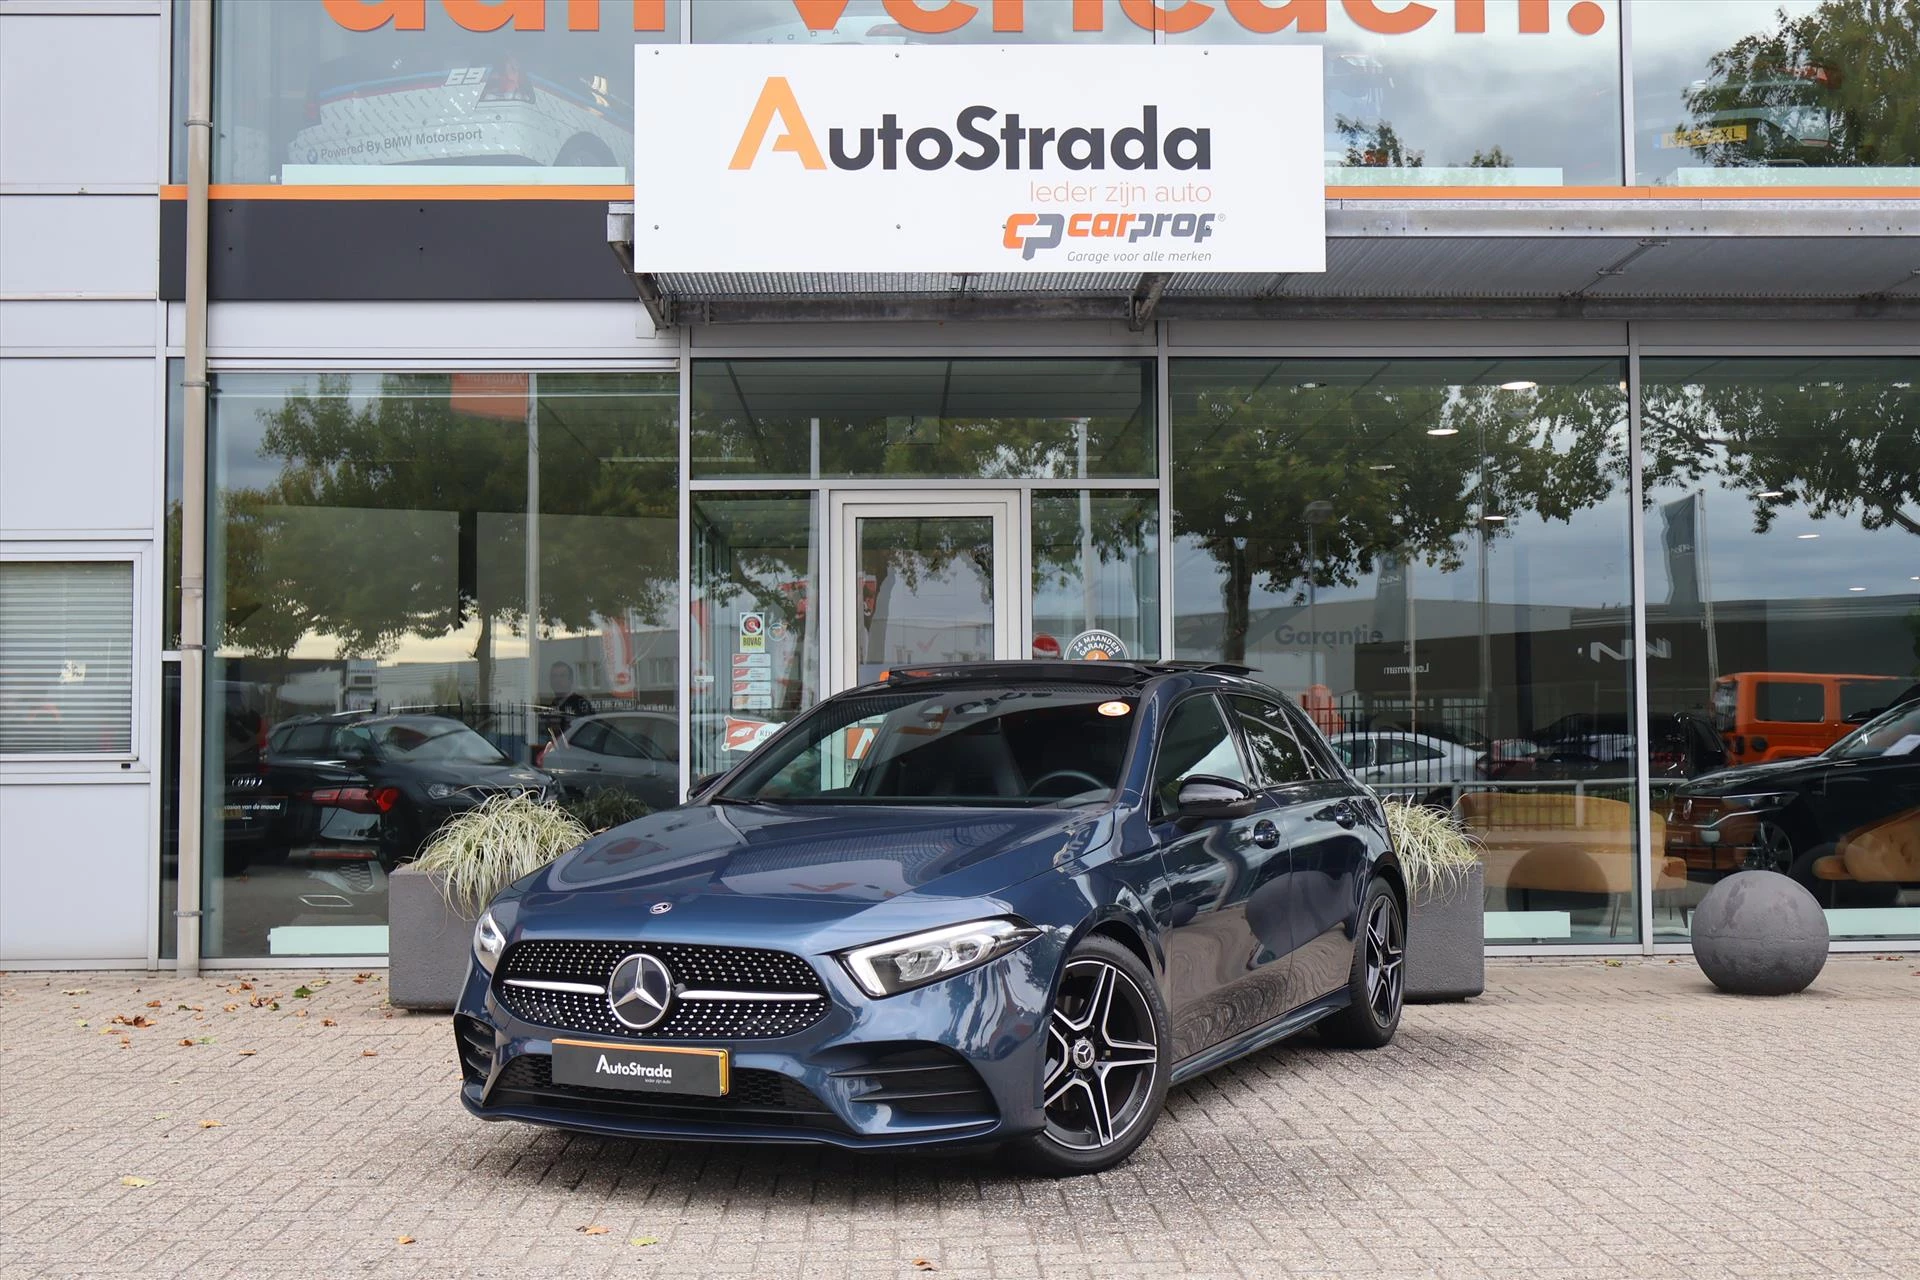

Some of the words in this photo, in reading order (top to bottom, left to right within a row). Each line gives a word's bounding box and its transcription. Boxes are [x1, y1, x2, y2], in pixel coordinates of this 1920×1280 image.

[445, 67, 486, 86] 69
[728, 77, 1211, 171] AutoStrada
[321, 142, 364, 160] Powered
[366, 141, 380, 153] By
[384, 135, 412, 149] BMW
[416, 129, 483, 146] Motorsport
[1030, 181, 1097, 203] Ieder
[1105, 181, 1146, 208] zijn
[1155, 182, 1212, 203] auto
[1067, 213, 1216, 243] carprof
[1067, 251, 1109, 264] Garage
[1113, 253, 1140, 262] voor
[1143, 251, 1165, 262] alle
[1168, 251, 1212, 262] merken
[743, 637, 762, 646] BOVAG
[1073, 641, 1083, 652] 24
[1083, 635, 1121, 653] MAANDEN
[1275, 624, 1384, 646] Garantie
[1080, 642, 1115, 657] GARANTIE
[596, 1054, 673, 1078] AutoStrada
